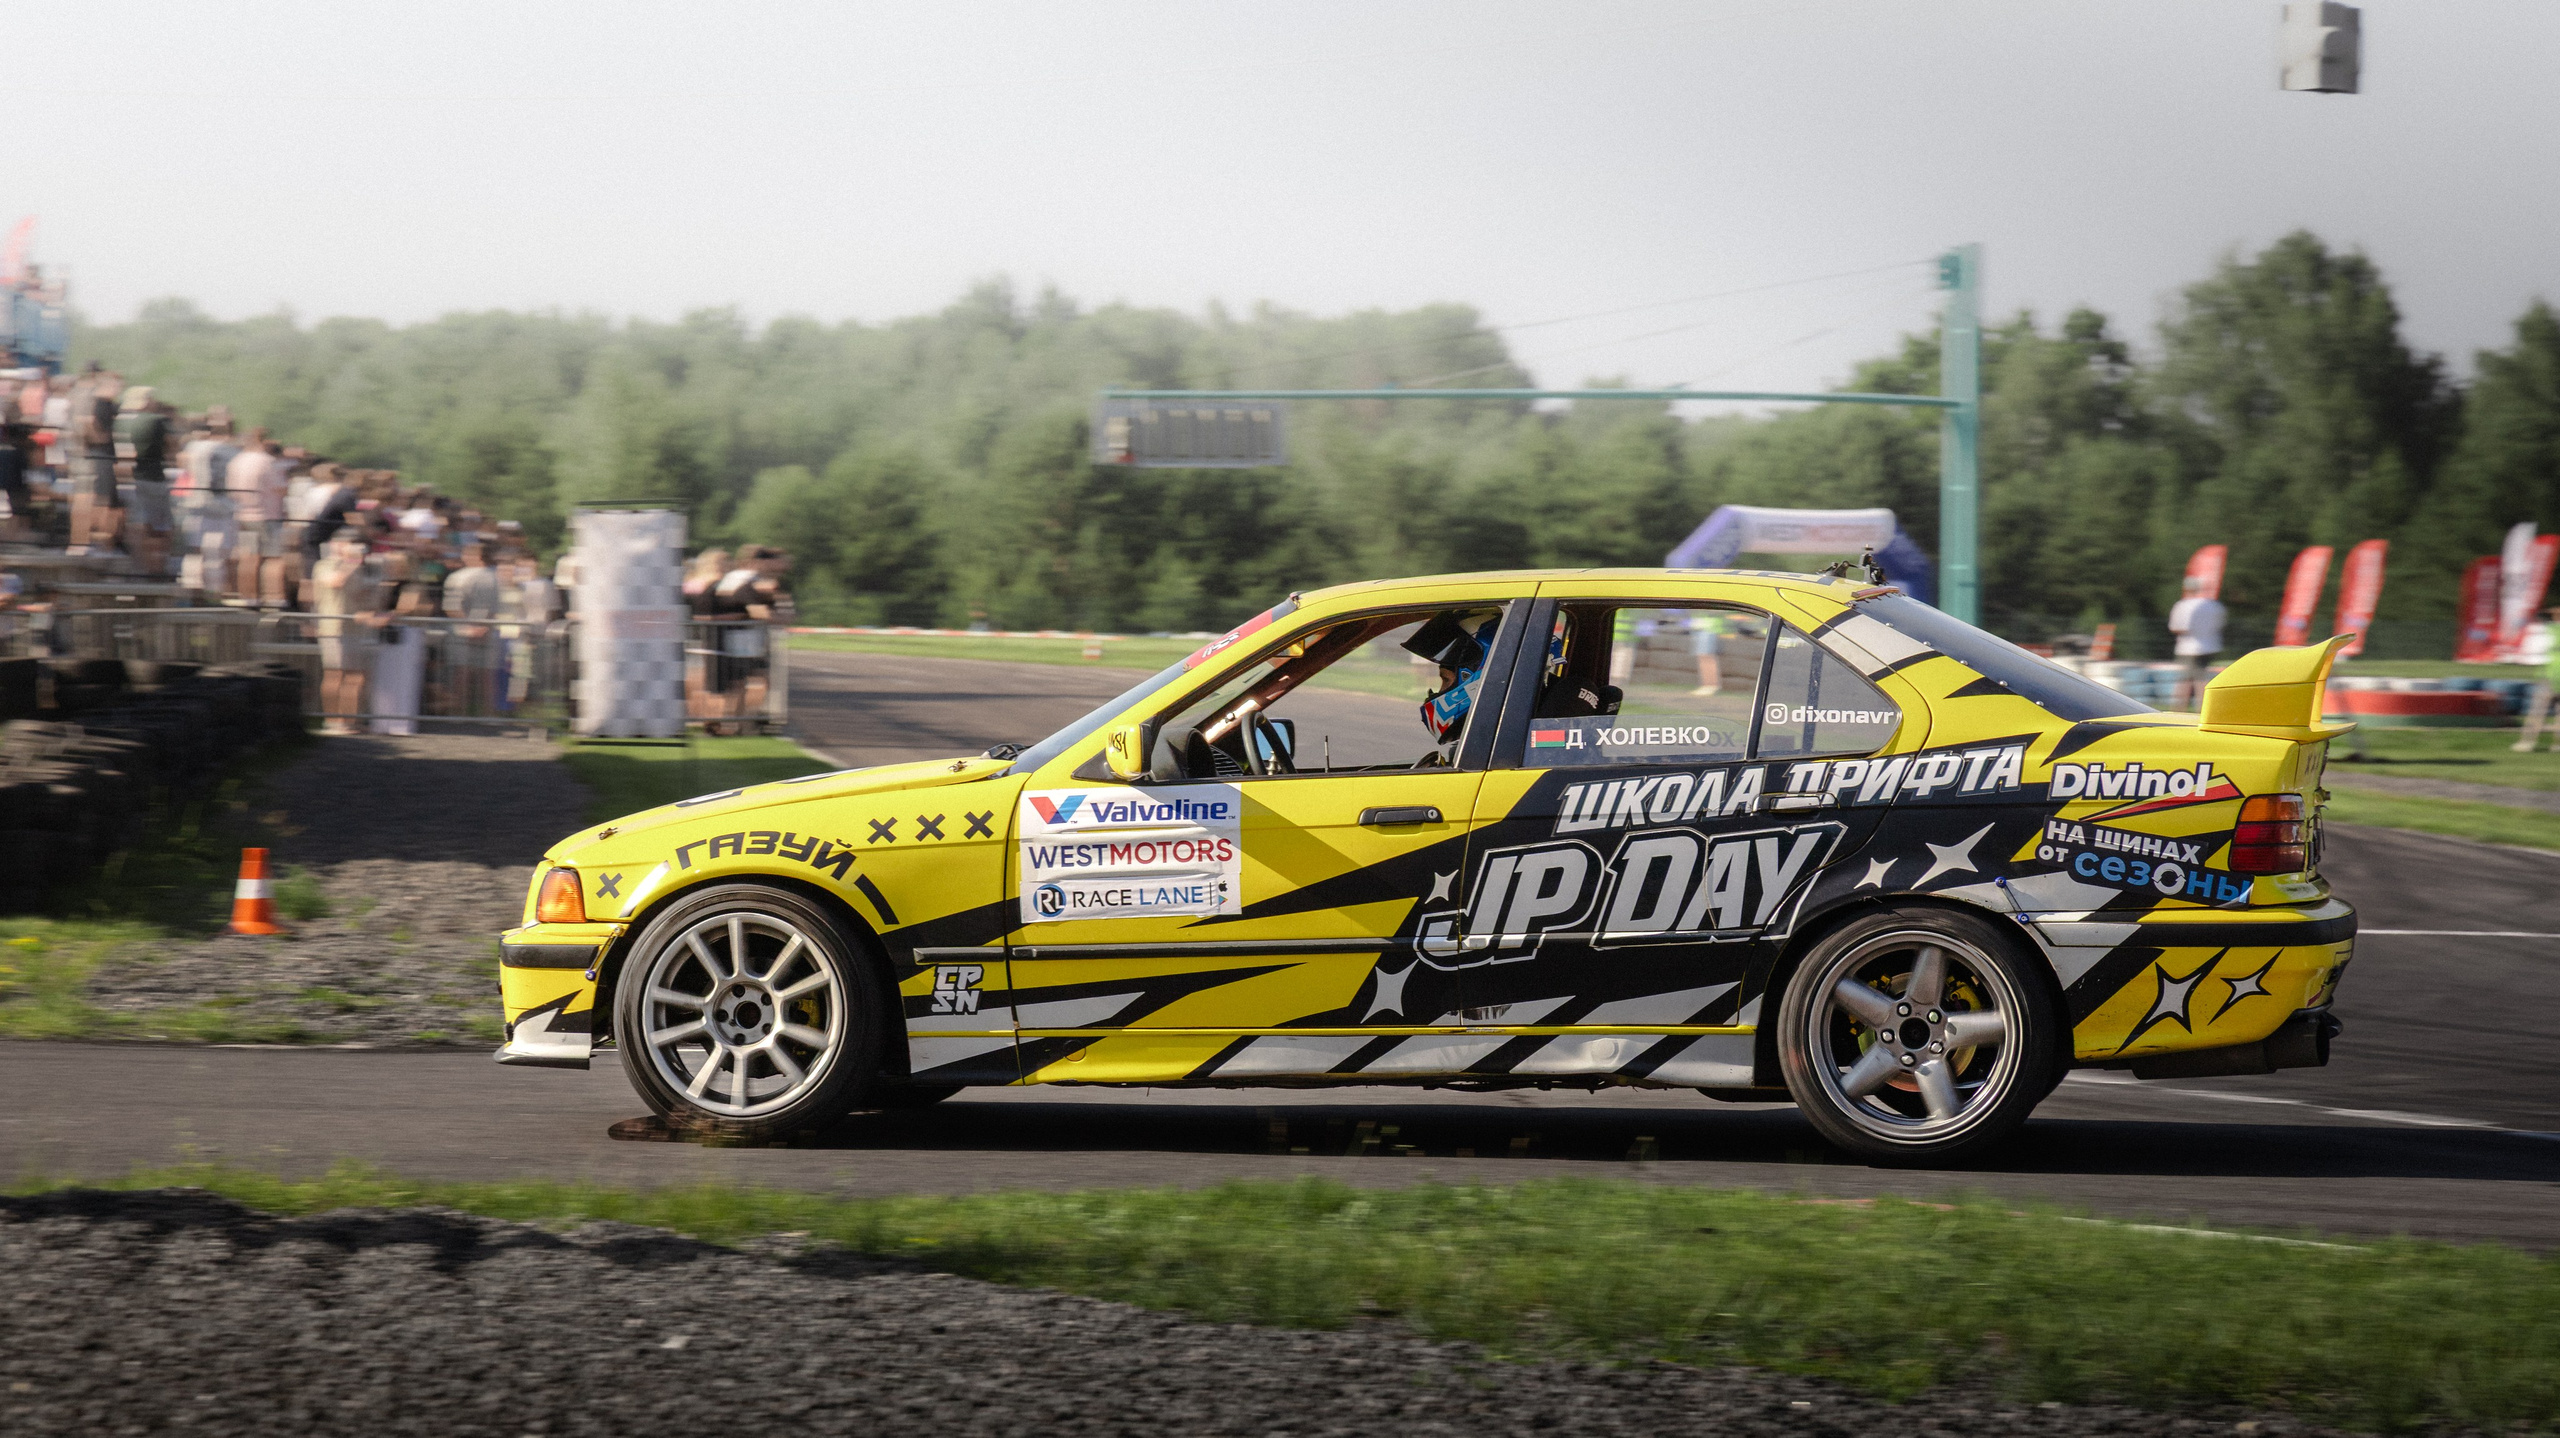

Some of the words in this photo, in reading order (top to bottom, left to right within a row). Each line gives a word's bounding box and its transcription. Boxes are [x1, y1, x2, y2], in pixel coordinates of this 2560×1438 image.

[1791, 705, 1895, 725] dixonavr
[1565, 728, 1587, 750] Д.
[1595, 726, 1711, 746] ХОЛЕВКО
[2050, 763, 2212, 799] Divinol
[1090, 798, 1229, 823] Valvoline
[1554, 766, 1766, 834] ШКОЛА
[675, 830, 857, 882] ГАЗУЙ
[1028, 838, 1233, 869] WESTMOTORS
[2038, 845, 2069, 863] от
[2046, 820, 2086, 845] НА
[2094, 829, 2202, 865] ШИНАХ
[1072, 889, 1133, 908] RACE
[1139, 886, 1204, 906] LANE
[1418, 842, 1597, 962] JP
[1598, 826, 1836, 940] DAY
